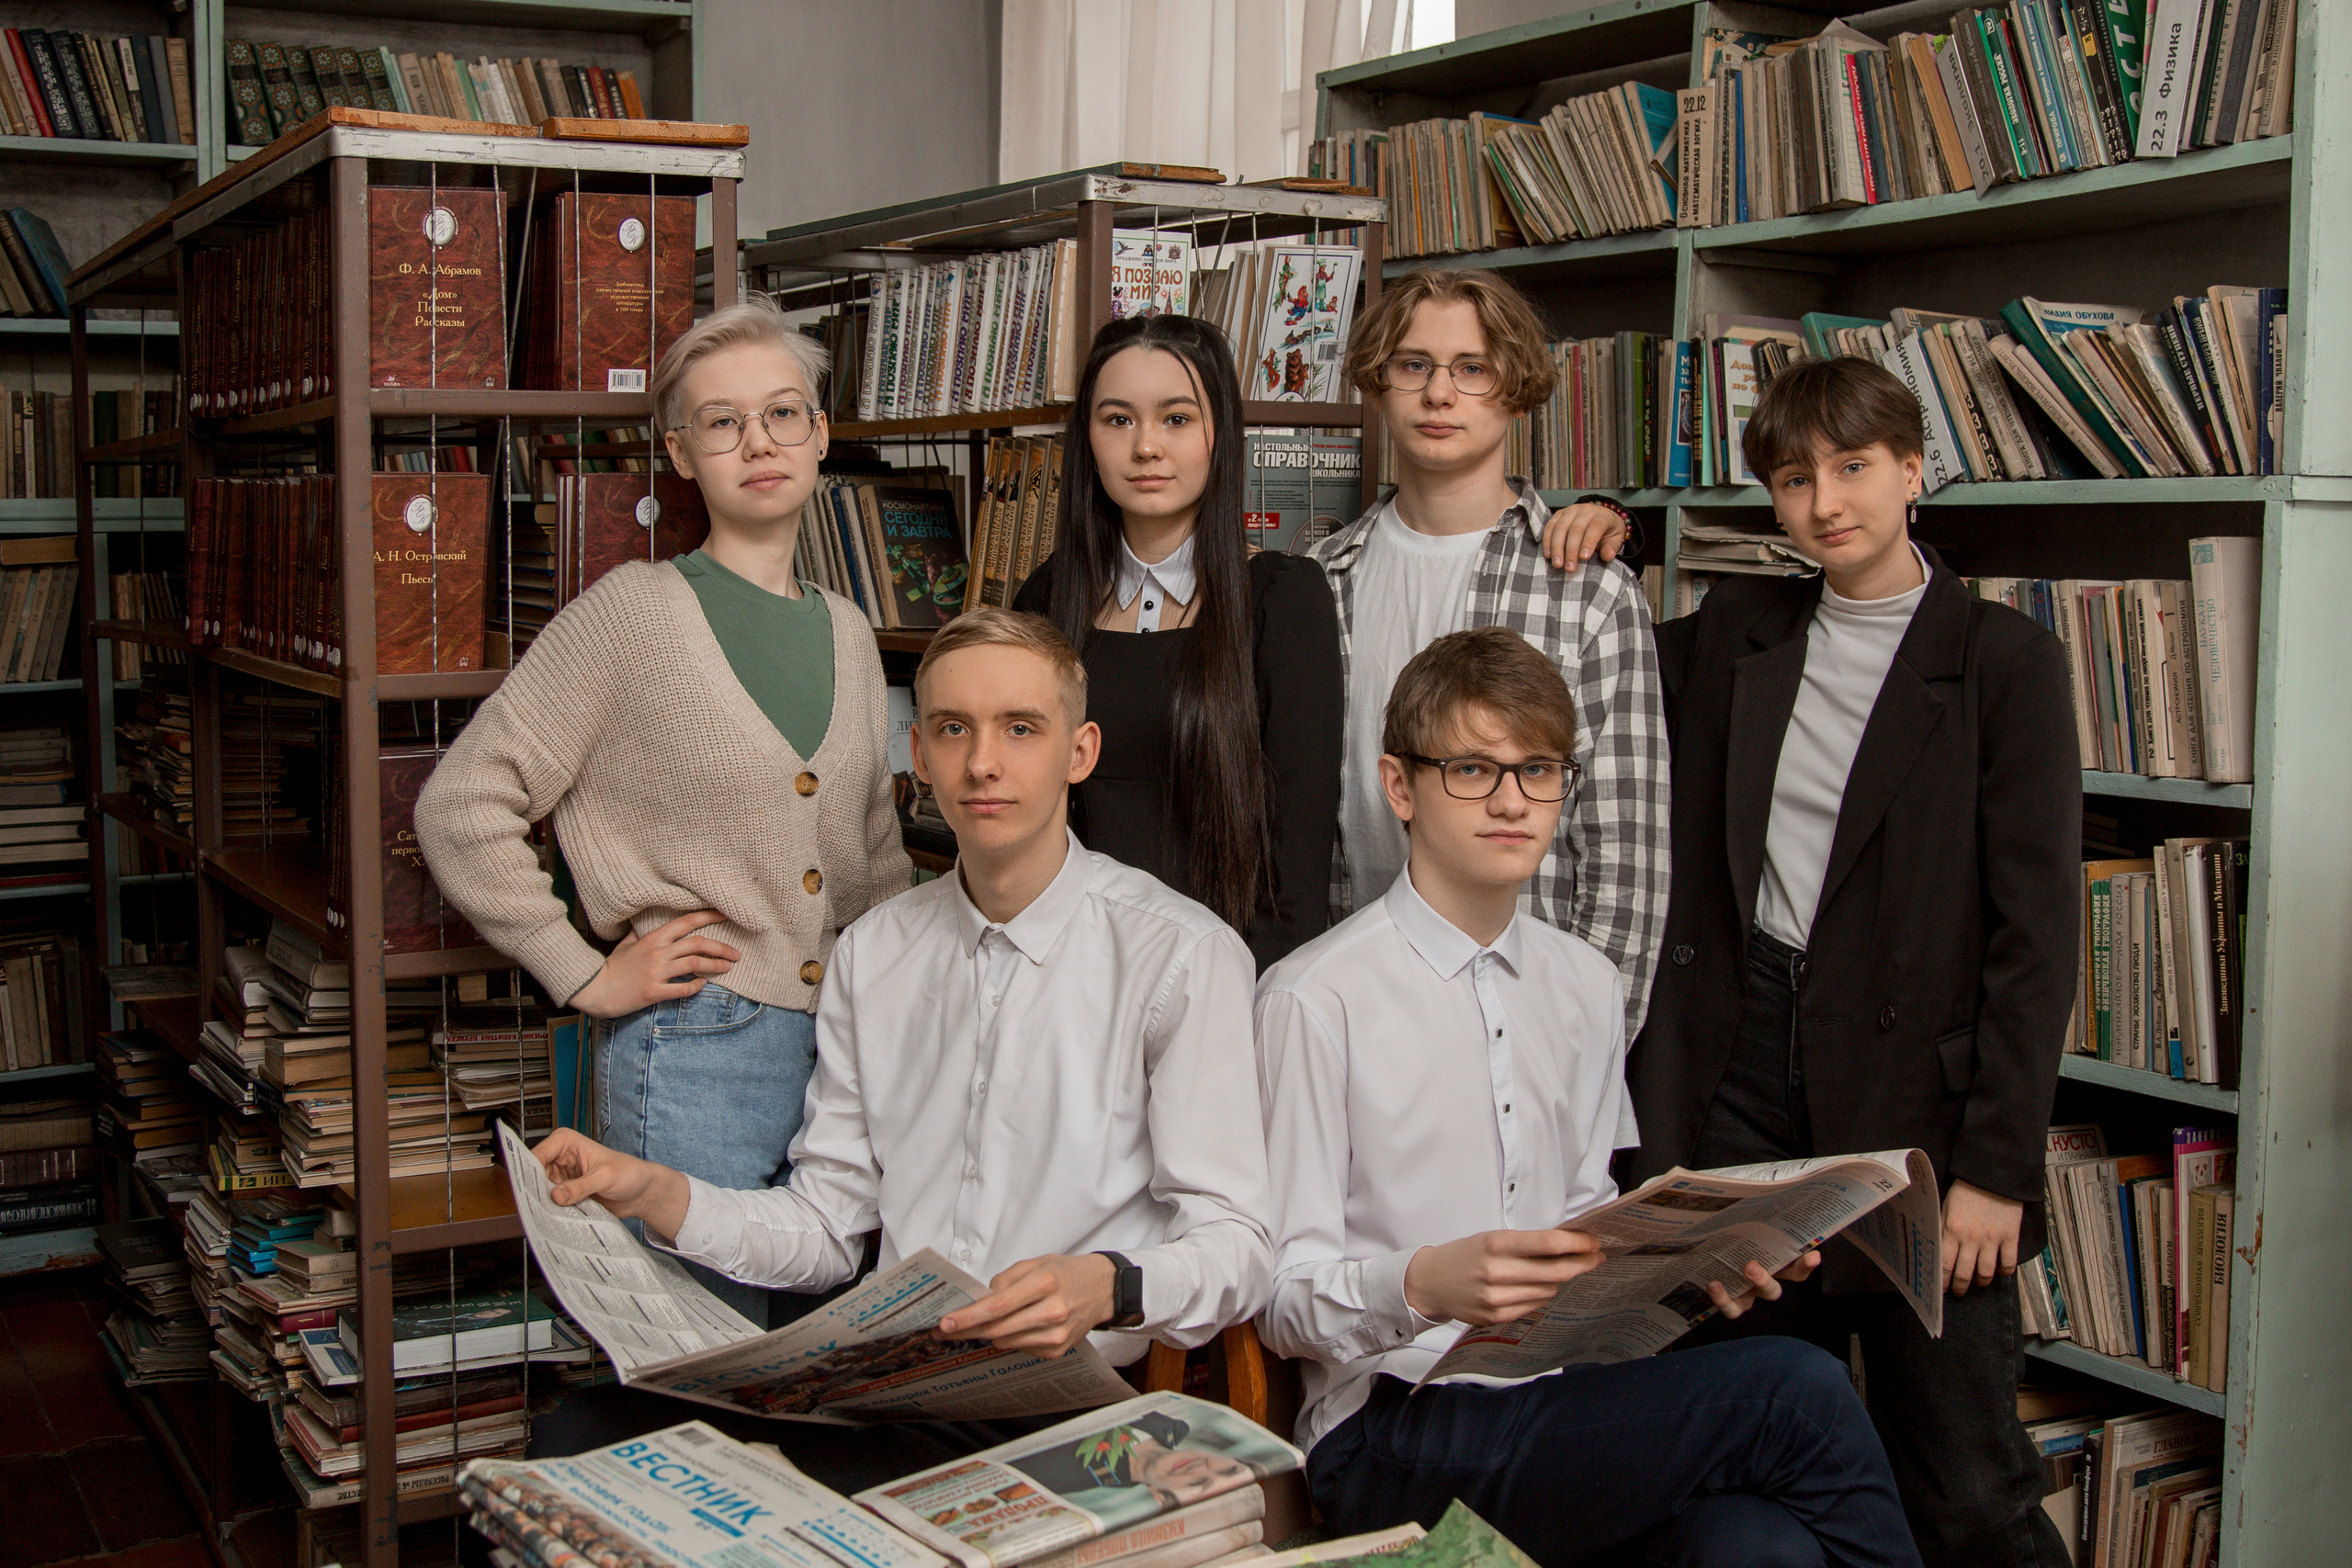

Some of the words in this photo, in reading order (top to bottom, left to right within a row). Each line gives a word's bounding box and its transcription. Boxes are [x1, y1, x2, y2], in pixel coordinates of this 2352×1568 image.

[2022, 5, 2035, 35] экологию
[1994, 53, 2007, 85] РОССИИ
[2030, 39, 2043, 71] биологию
[1948, 52, 1974, 133] Экология
[2040, 76, 2052, 106] Введение
[2151, 110, 2167, 151] 22.3
[2159, 23, 2182, 98] Физика
[1684, 96, 1706, 113] 22.12
[2002, 85, 2019, 125] ЭКОЛОГИЯ
[2048, 111, 2062, 148] ПРИРОДА
[1681, 119, 1690, 172] МАТЕМАТИКА
[1974, 145, 1988, 180] 20.1
[1692, 148, 1701, 215] МАТЕМАТИЧЕСКАЯ
[399, 263, 414, 275] Ф.
[418, 264, 431, 275] А.
[435, 264, 481, 276] Абрамов
[1112, 265, 1121, 282] Я
[1125, 266, 1183, 285] ПОЗНАЮ
[418, 301, 462, 313] Повести
[962, 289, 971, 323] МИР
[976, 284, 984, 317] МИР
[992, 284, 1002, 317] МИР
[1130, 284, 1160, 299] МИР
[415, 316, 465, 327] Рассказы
[868, 302, 879, 333] МИР
[891, 298, 900, 330] МИР
[2043, 309, 2072, 319] ЛИДИЯ
[2075, 310, 2114, 321] ОБУХОВА
[2192, 316, 2206, 343] ВРЕМЯ
[954, 326, 967, 388] ПОЗНАЮ
[966, 321, 981, 387] ПОЗНАЮ
[984, 321, 999, 384] ПОЗНАЮ
[1971, 333, 1997, 383] АСТРОНОМИИ
[2165, 322, 2188, 368] СТУПЕНИ
[2200, 343, 2212, 365] ЧЕРЕЗ
[863, 336, 876, 395] ПОЗНАЮ
[887, 333, 898, 392] ПОЗНАЮ
[2207, 365, 2219, 385] МОСТ
[2275, 348, 2283, 378] ЧКАЛОВ
[860, 399, 870, 409] Я
[885, 395, 895, 406] Я
[952, 389, 960, 402] Я
[965, 388, 974, 400] Я
[982, 385, 991, 399] Я
[1993, 384, 2002, 395] ПО
[2182, 367, 2205, 411] ПЕРВЫЕ
[2275, 380, 2283, 412] ВАЛЕРИЙ
[1998, 397, 2016, 426] ЧТЕНИЯ
[1253, 442, 1310, 452] НСТОЛЬНЫЙ
[2012, 427, 2023, 444] ДЛЯ
[1253, 451, 1361, 469] СПРАВОЧНИК
[1930, 450, 1949, 487] 22.6
[2019, 445, 2034, 468] КНИГА
[842, 499, 854, 541] АСТРОНОМИИ
[882, 502, 945, 511] КОСМОНАВТИКА
[884, 511, 948, 525] СЕГОДНЯ
[1251, 513, 1257, 522] 2
[851, 543, 857, 552] ПО
[887, 525, 898, 536] И
[901, 525, 952, 539] ЗАВТРА
[995, 503, 1011, 572] ШКОЛЬНАЯ
[1016, 502, 1030, 572] ШКОЛЬНАЯ
[389, 550, 401, 561] Н.
[405, 550, 467, 562] Островский
[853, 553, 863, 580] ЧТЕНИЯ
[2198, 599, 2204, 608] И
[2179, 599, 2189, 659] АСТРОНОМИИ
[2199, 610, 2208, 648] НАУКА
[2209, 598, 2221, 682] ЧЕЛОВЕЧЕСТВО
[2138, 622, 2147, 674] неорганической
[2184, 661, 2191, 673] ПО
[2172, 671, 2181, 723] АСТРОНОМИЯ
[2185, 677, 2194, 711] ЧТЕНИЯ
[2188, 715, 2196, 733] ДЛЯ
[2148, 748, 2154, 758] 2
[2189, 736, 2198, 764] КНИГА
[2212, 852, 2223, 902] Молдавии
[2102, 895, 2110, 950] ГЕОГРАФИЯ
[2215, 910, 2227, 953] Украины
[2102, 953, 2110, 1011] ФИЗИЧЕСКАЯ
[2219, 953, 2229, 1014] Заповедники
[2052, 1134, 2097, 1151] КУСТО
[1879, 1179, 1894, 1190] 22
[2100, 1175, 2111, 1213] БИОЛОГИИ
[2107, 1215, 2116, 1241] ОБЩЕЙ
[2197, 1207, 2205, 1256] БИОЛОГИЯ
[2110, 1244, 2117, 1253] ПО
[2214, 1213, 2227, 1285] БИОЛОГИЯ
[2112, 1255, 2124, 1303] УПРАЖНЕНИЯ
[2195, 1260, 2203, 1327] СОВРЕМЕННАЯ
[2120, 1311, 2131, 1341] ЗАДАЧИ
[932, 1372, 989, 1395] Татьяны
[412, 1475, 450, 1490] РАССКАЗЫ
[610, 1441, 774, 1527] ВЕСТНИК
[964, 1493, 1050, 1530] ПРОДАЖА
[1129, 1520, 1186, 1549] КУЗНИЦА
